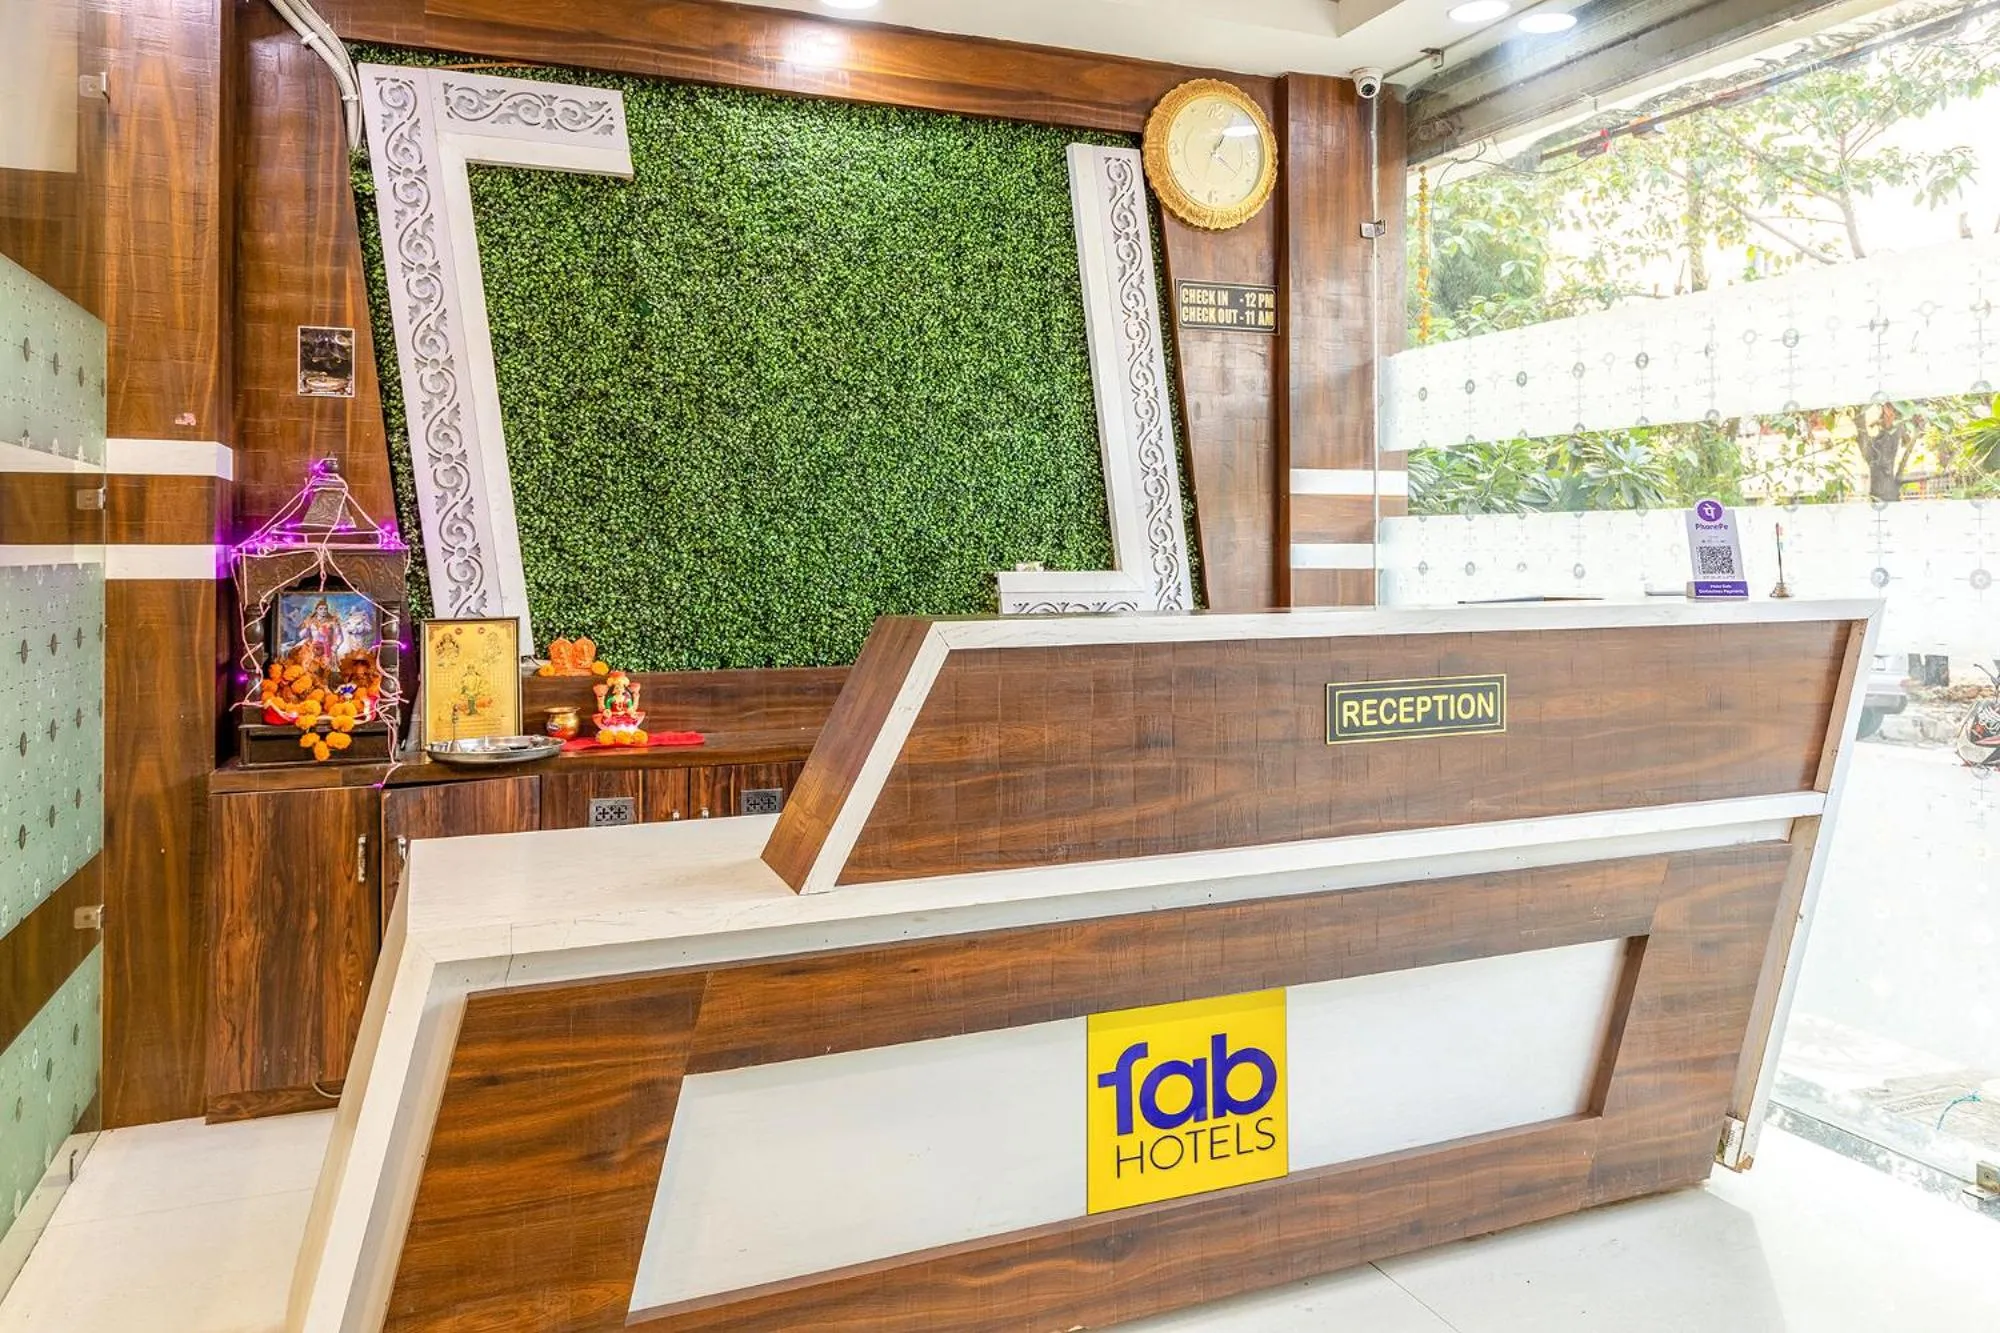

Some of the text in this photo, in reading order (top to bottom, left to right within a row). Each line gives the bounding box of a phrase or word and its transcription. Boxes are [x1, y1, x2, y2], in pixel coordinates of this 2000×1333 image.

[1182, 288, 1216, 306] CHECK
[1217, 290, 1229, 306] IN
[1258, 293, 1274, 308] PM
[1182, 306, 1216, 323] CHECK
[1217, 308, 1239, 324] OUT
[1258, 311, 1274, 326] AM
[1342, 691, 1495, 729] RECEPTION
[1097, 1033, 1278, 1137] fab
[1116, 1116, 1276, 1179] HOTELS
